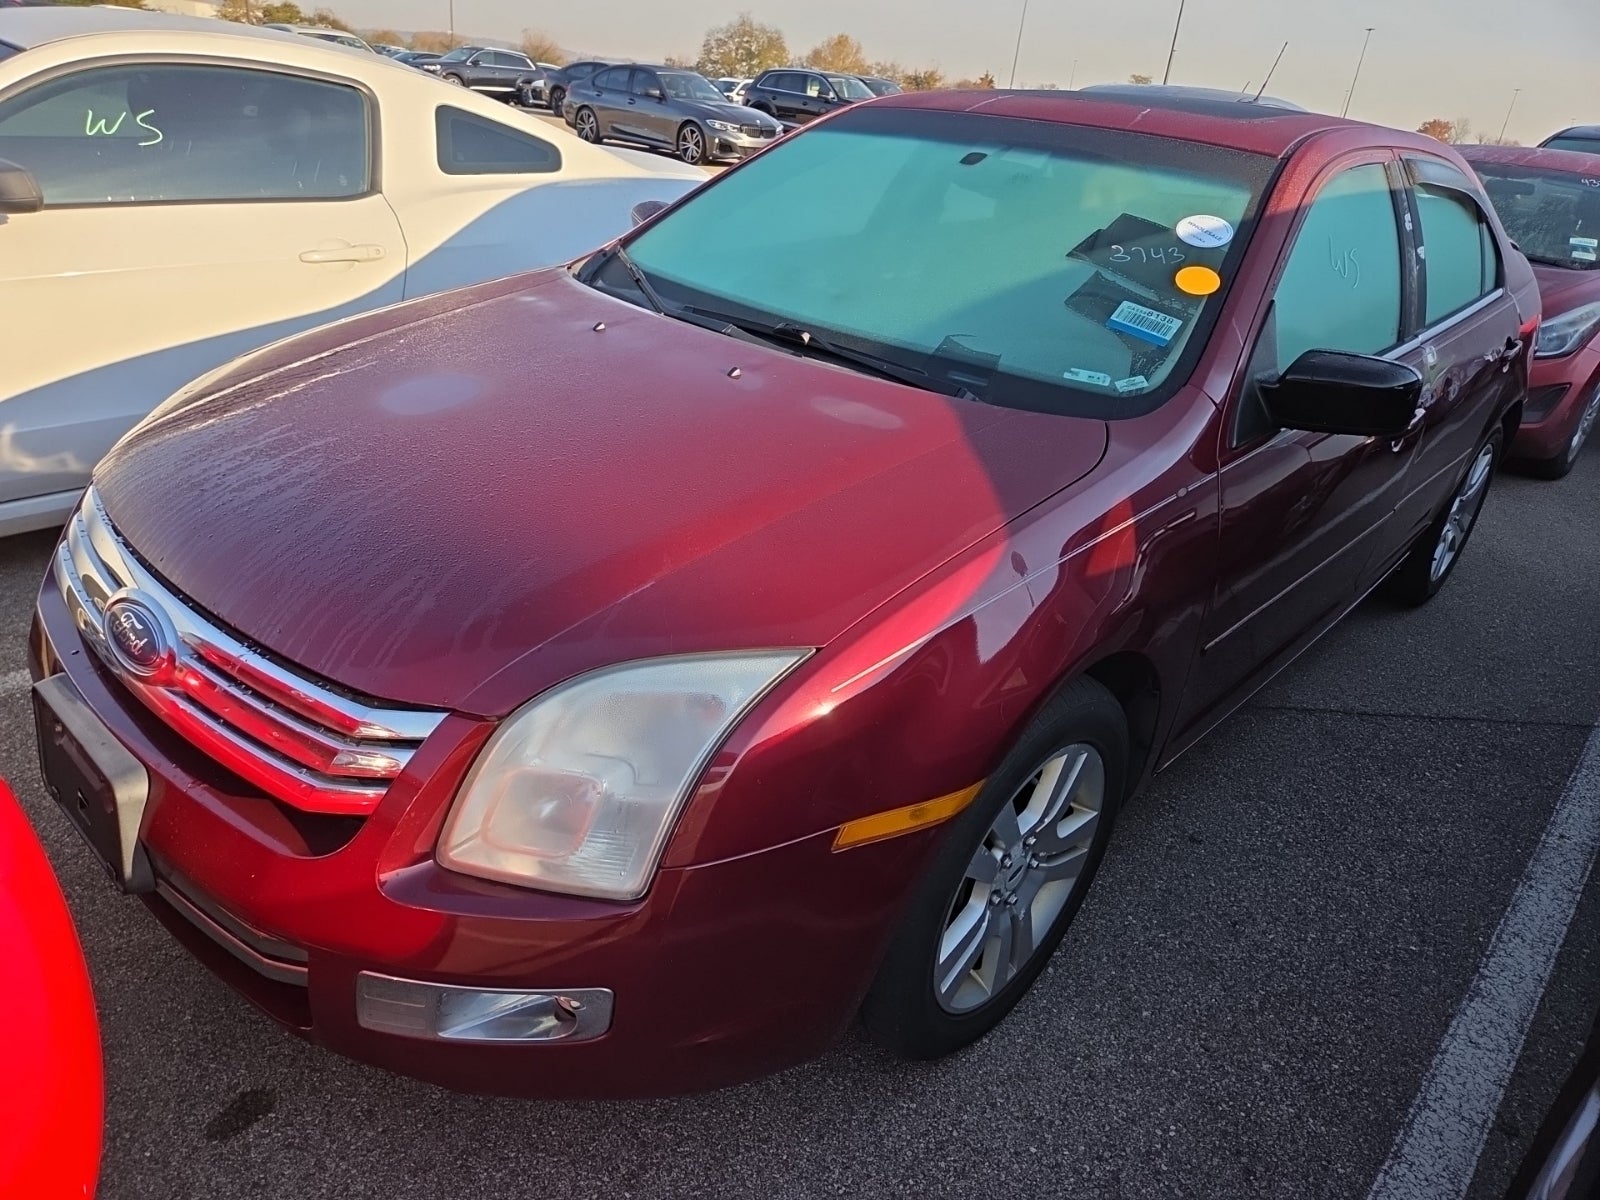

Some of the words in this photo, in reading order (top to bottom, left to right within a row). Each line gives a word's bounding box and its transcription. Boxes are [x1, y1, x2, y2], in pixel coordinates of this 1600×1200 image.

[1581, 178, 1600, 188] 43
[1187, 221, 1224, 241] WHOLESALE
[1109, 245, 1185, 264] 3743
[1328, 233, 1360, 289] WS
[114, 612, 148, 655] Ford
